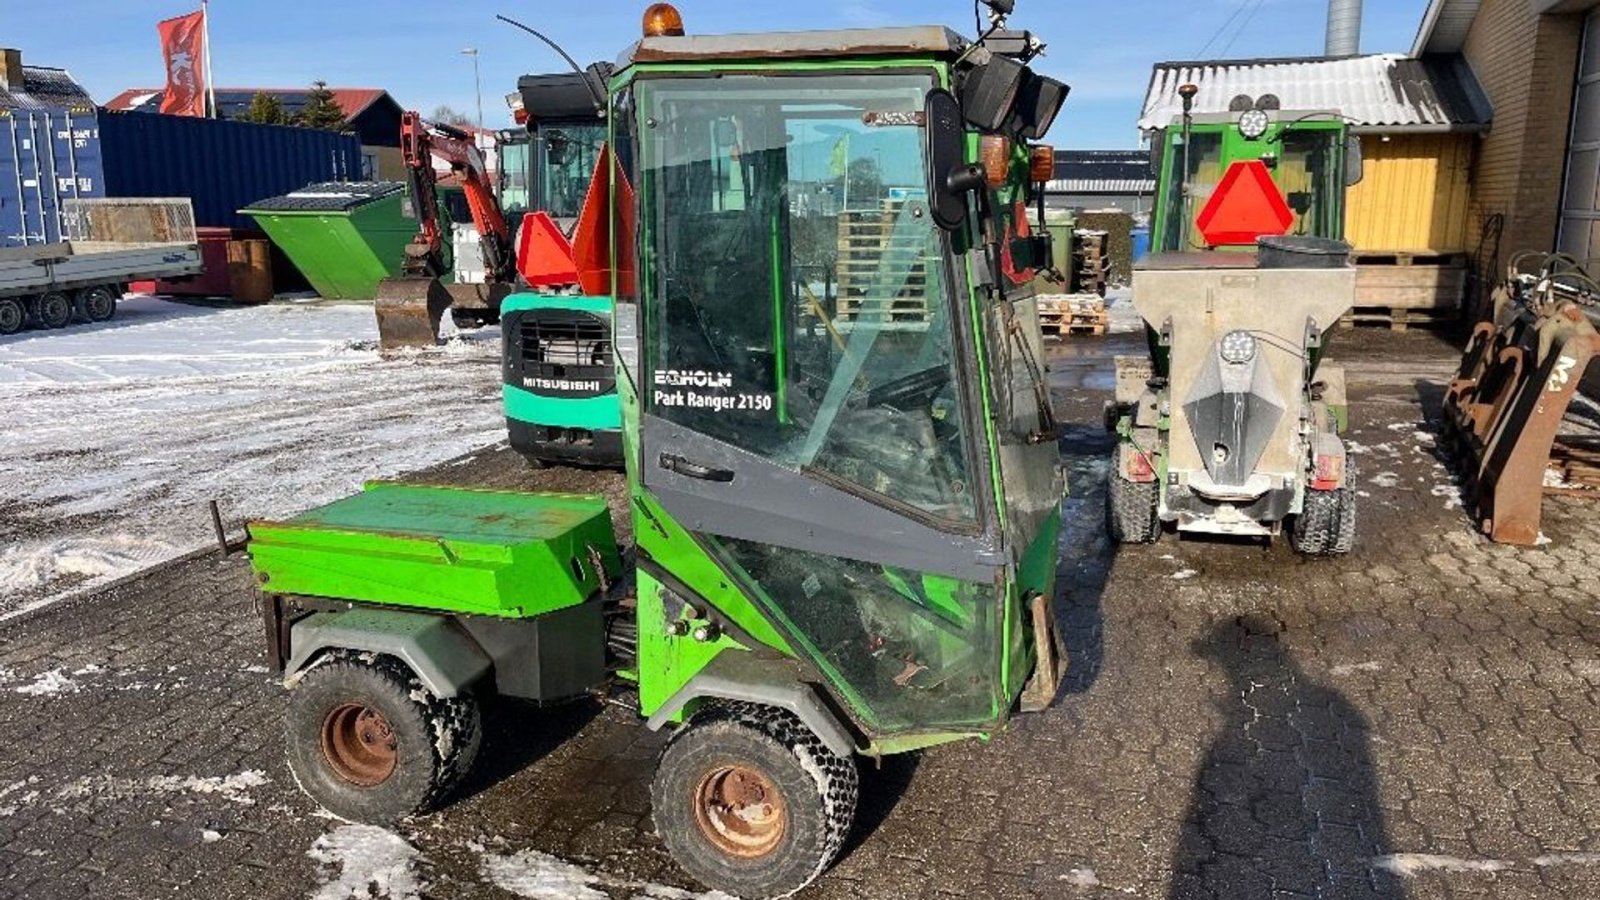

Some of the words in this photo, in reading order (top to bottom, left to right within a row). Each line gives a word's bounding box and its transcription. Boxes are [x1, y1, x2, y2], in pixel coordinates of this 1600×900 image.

[523, 377, 600, 391] MITSUBISHI
[654, 390, 685, 406] Park
[687, 391, 735, 412] Ranger
[737, 394, 772, 411] 2150
